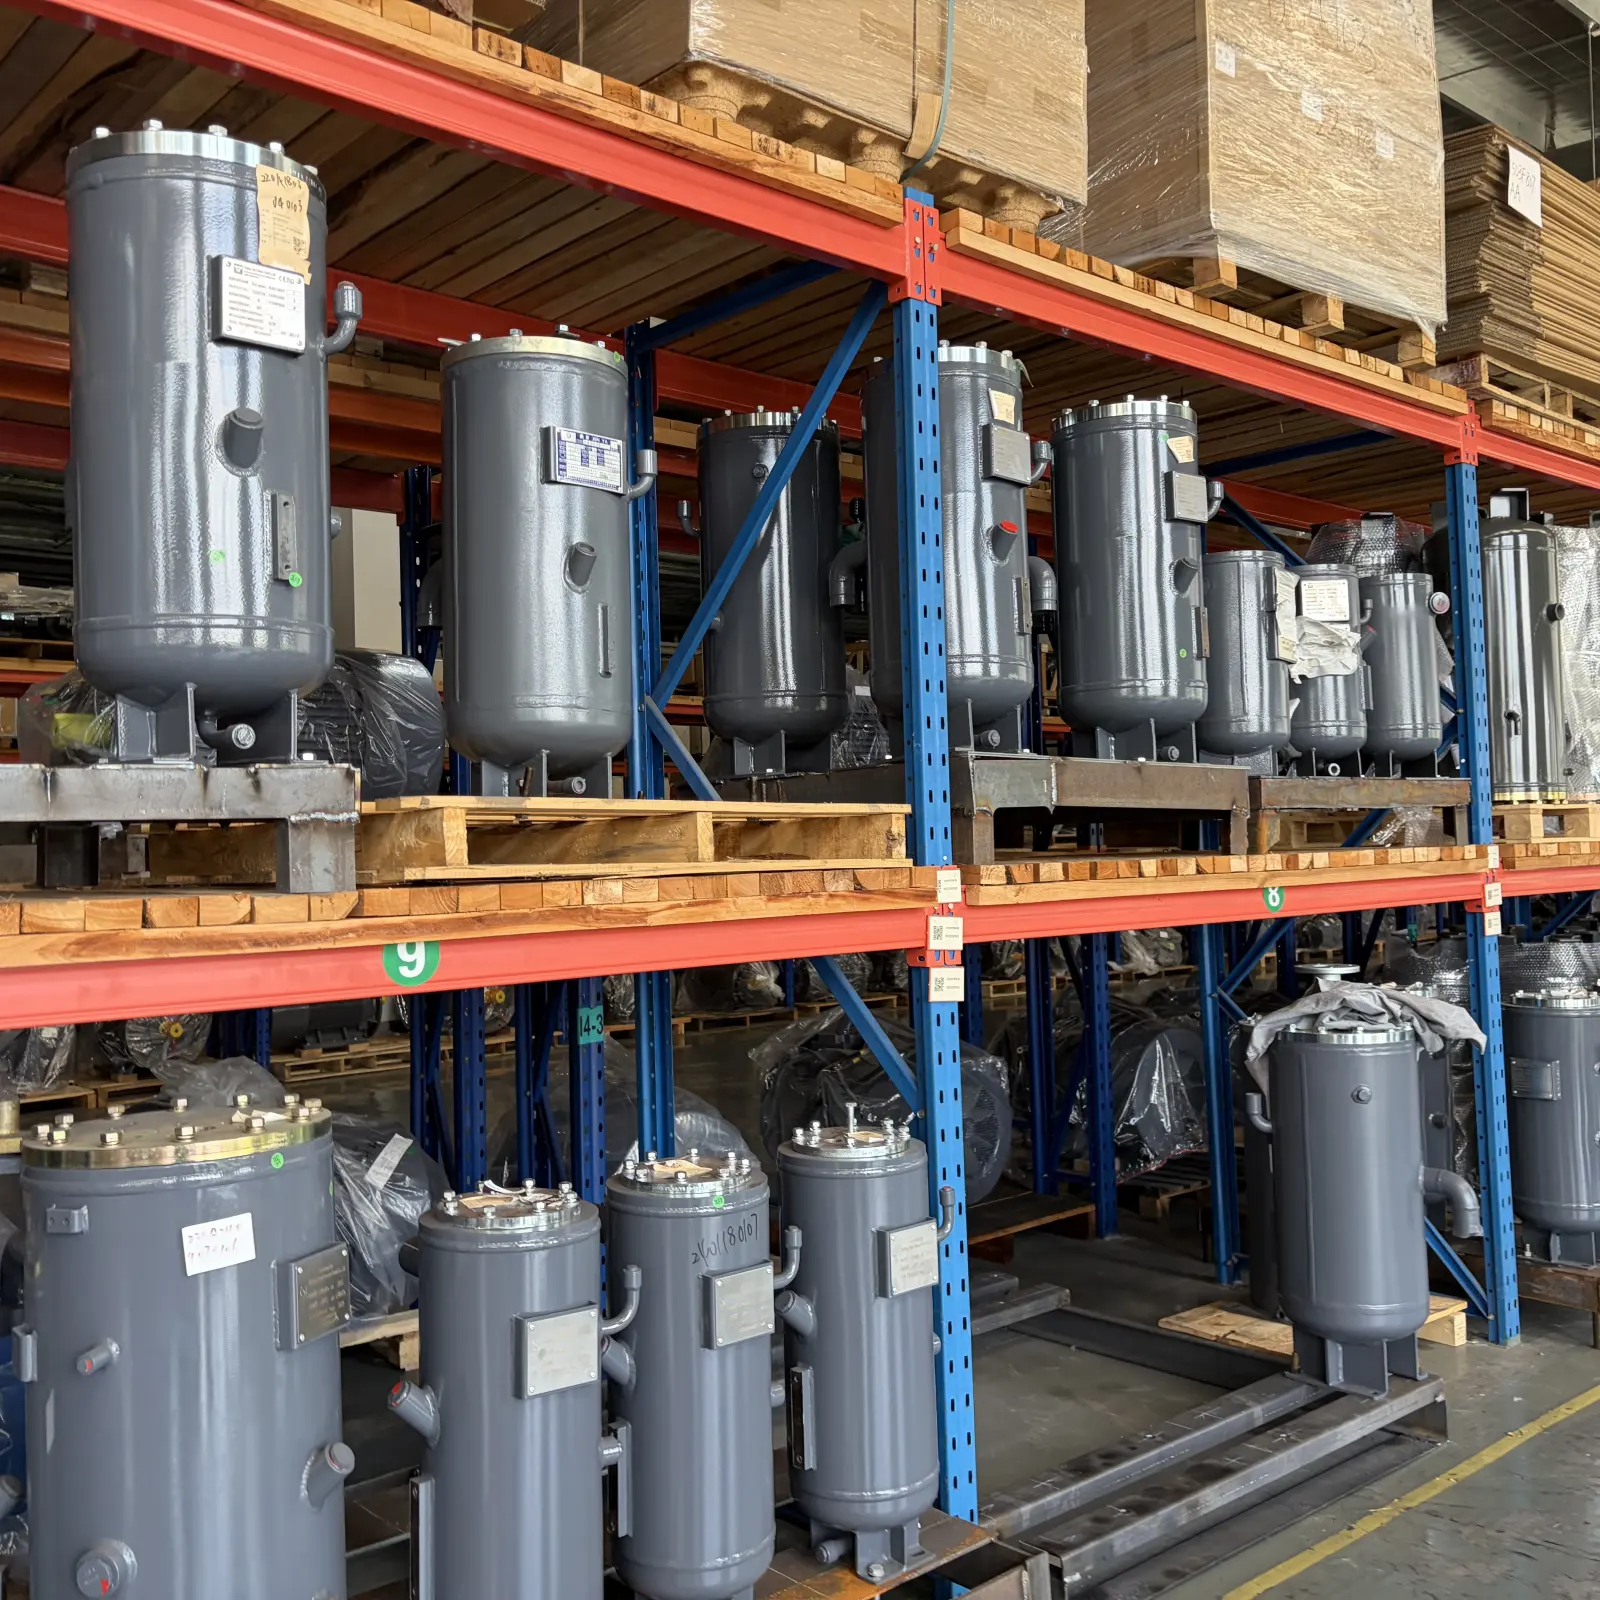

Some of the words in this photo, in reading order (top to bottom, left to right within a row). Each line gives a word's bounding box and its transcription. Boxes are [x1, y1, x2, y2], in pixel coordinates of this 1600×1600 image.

[1268, 887, 1280, 907] 8
[397, 941, 426, 978] 9
[579, 1013, 604, 1037] 14-3
